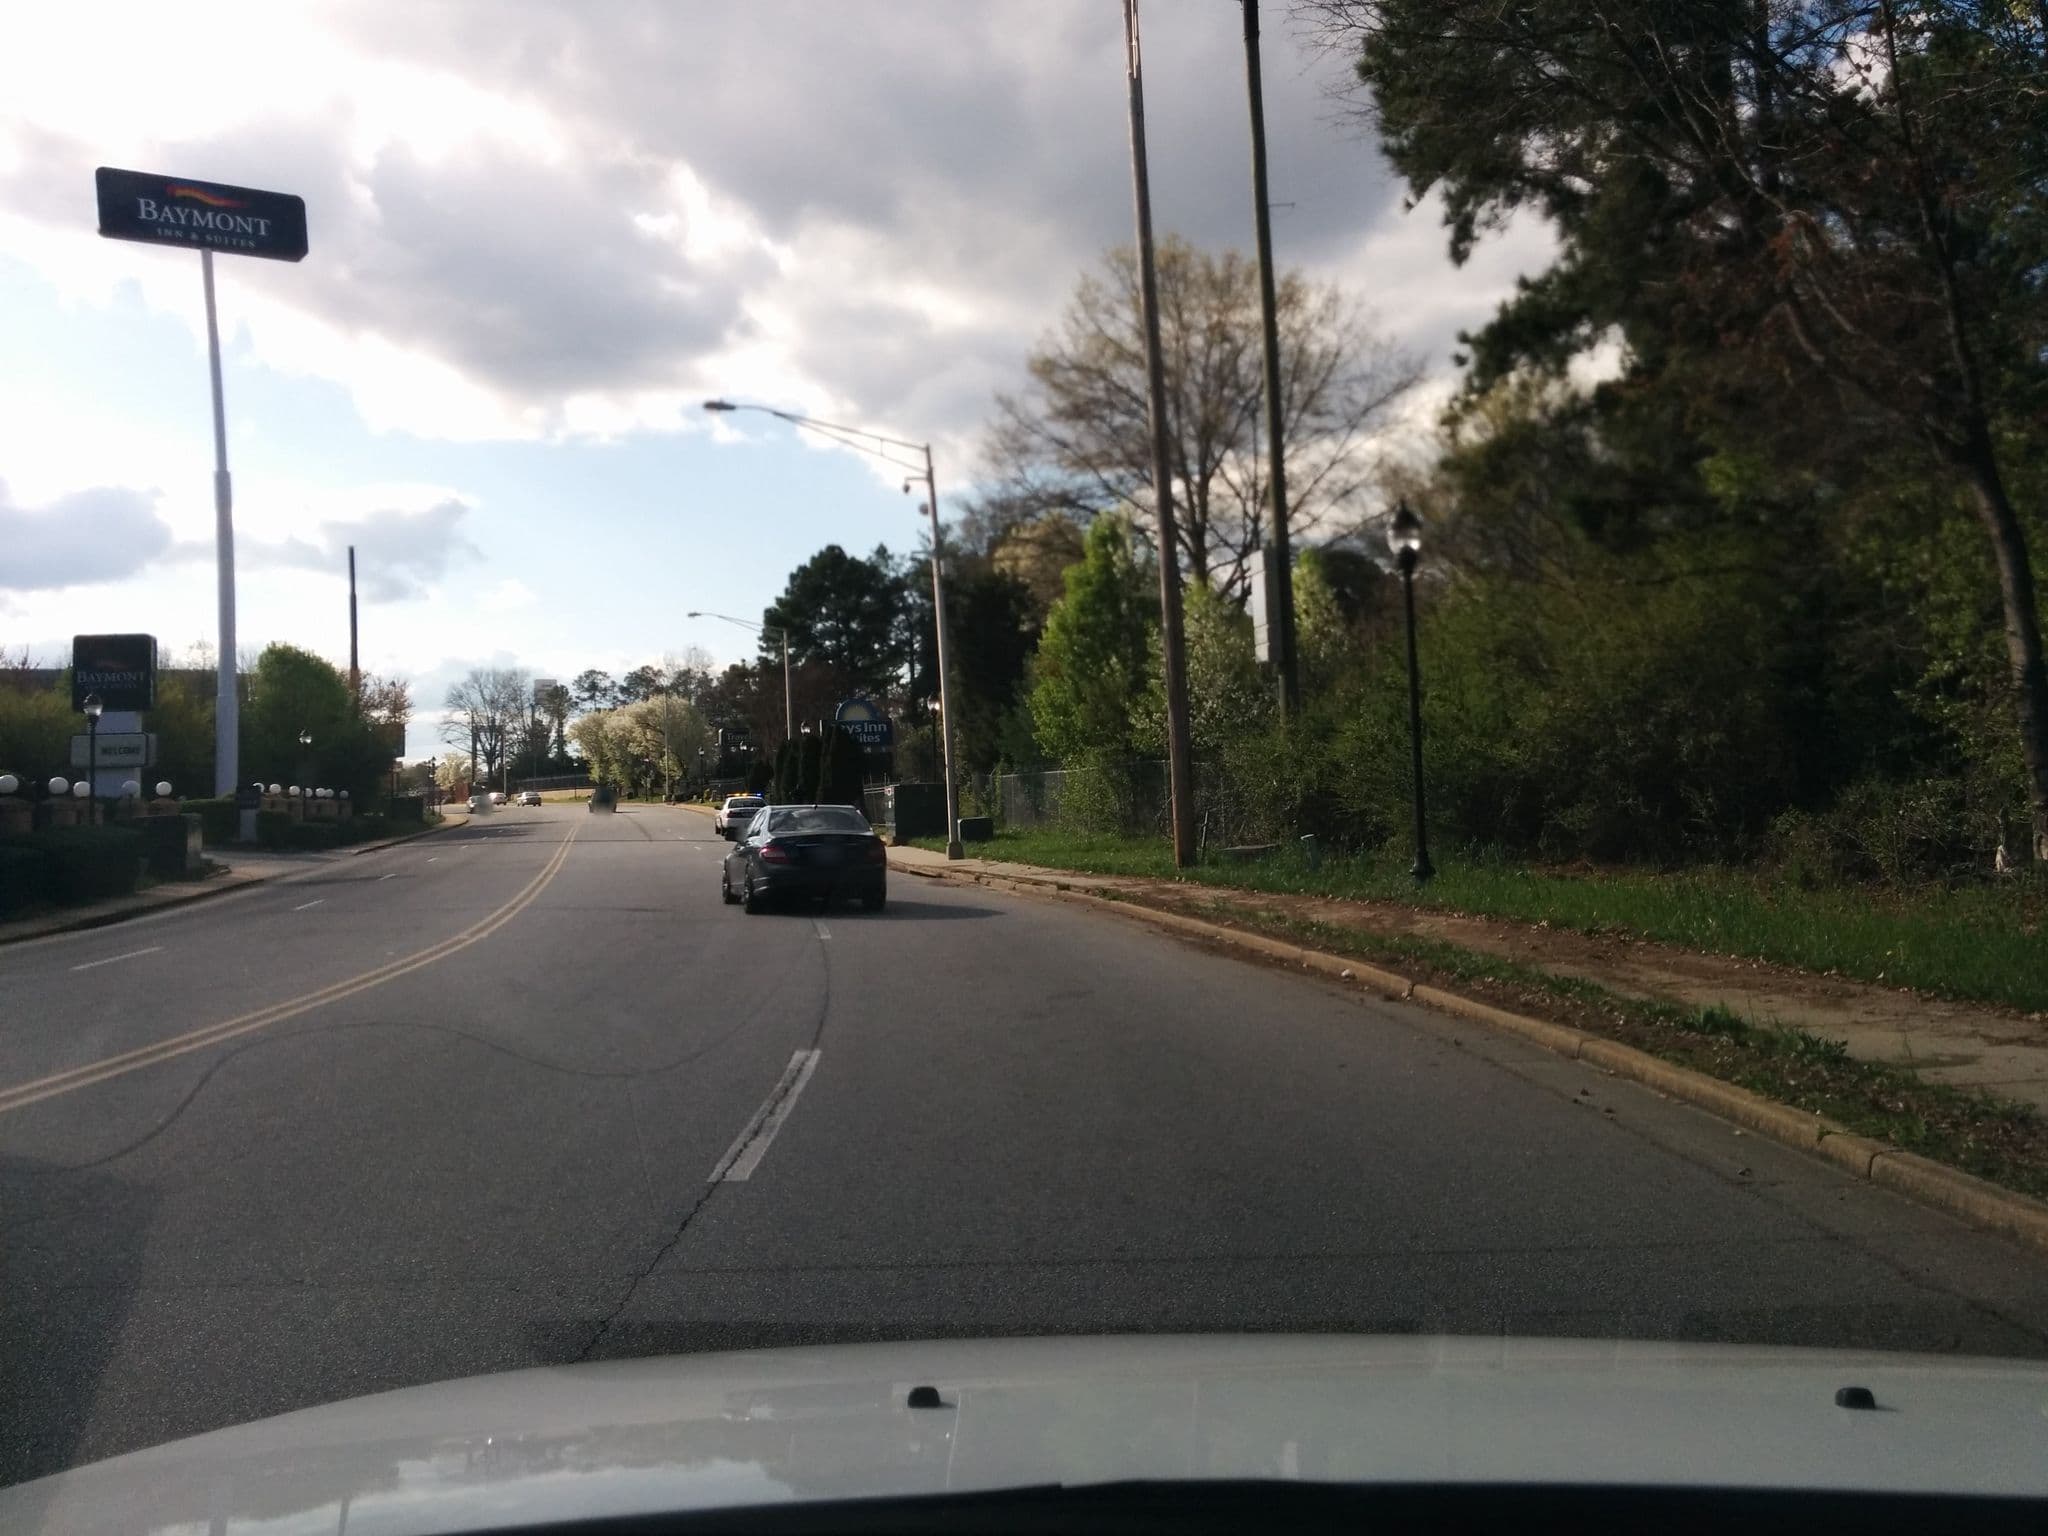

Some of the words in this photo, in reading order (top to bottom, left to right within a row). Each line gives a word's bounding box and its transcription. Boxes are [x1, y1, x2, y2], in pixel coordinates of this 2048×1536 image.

[136, 197, 271, 236] BAYMONT
[205, 233, 256, 248] SUITES
[863, 722, 887, 732] Inn
